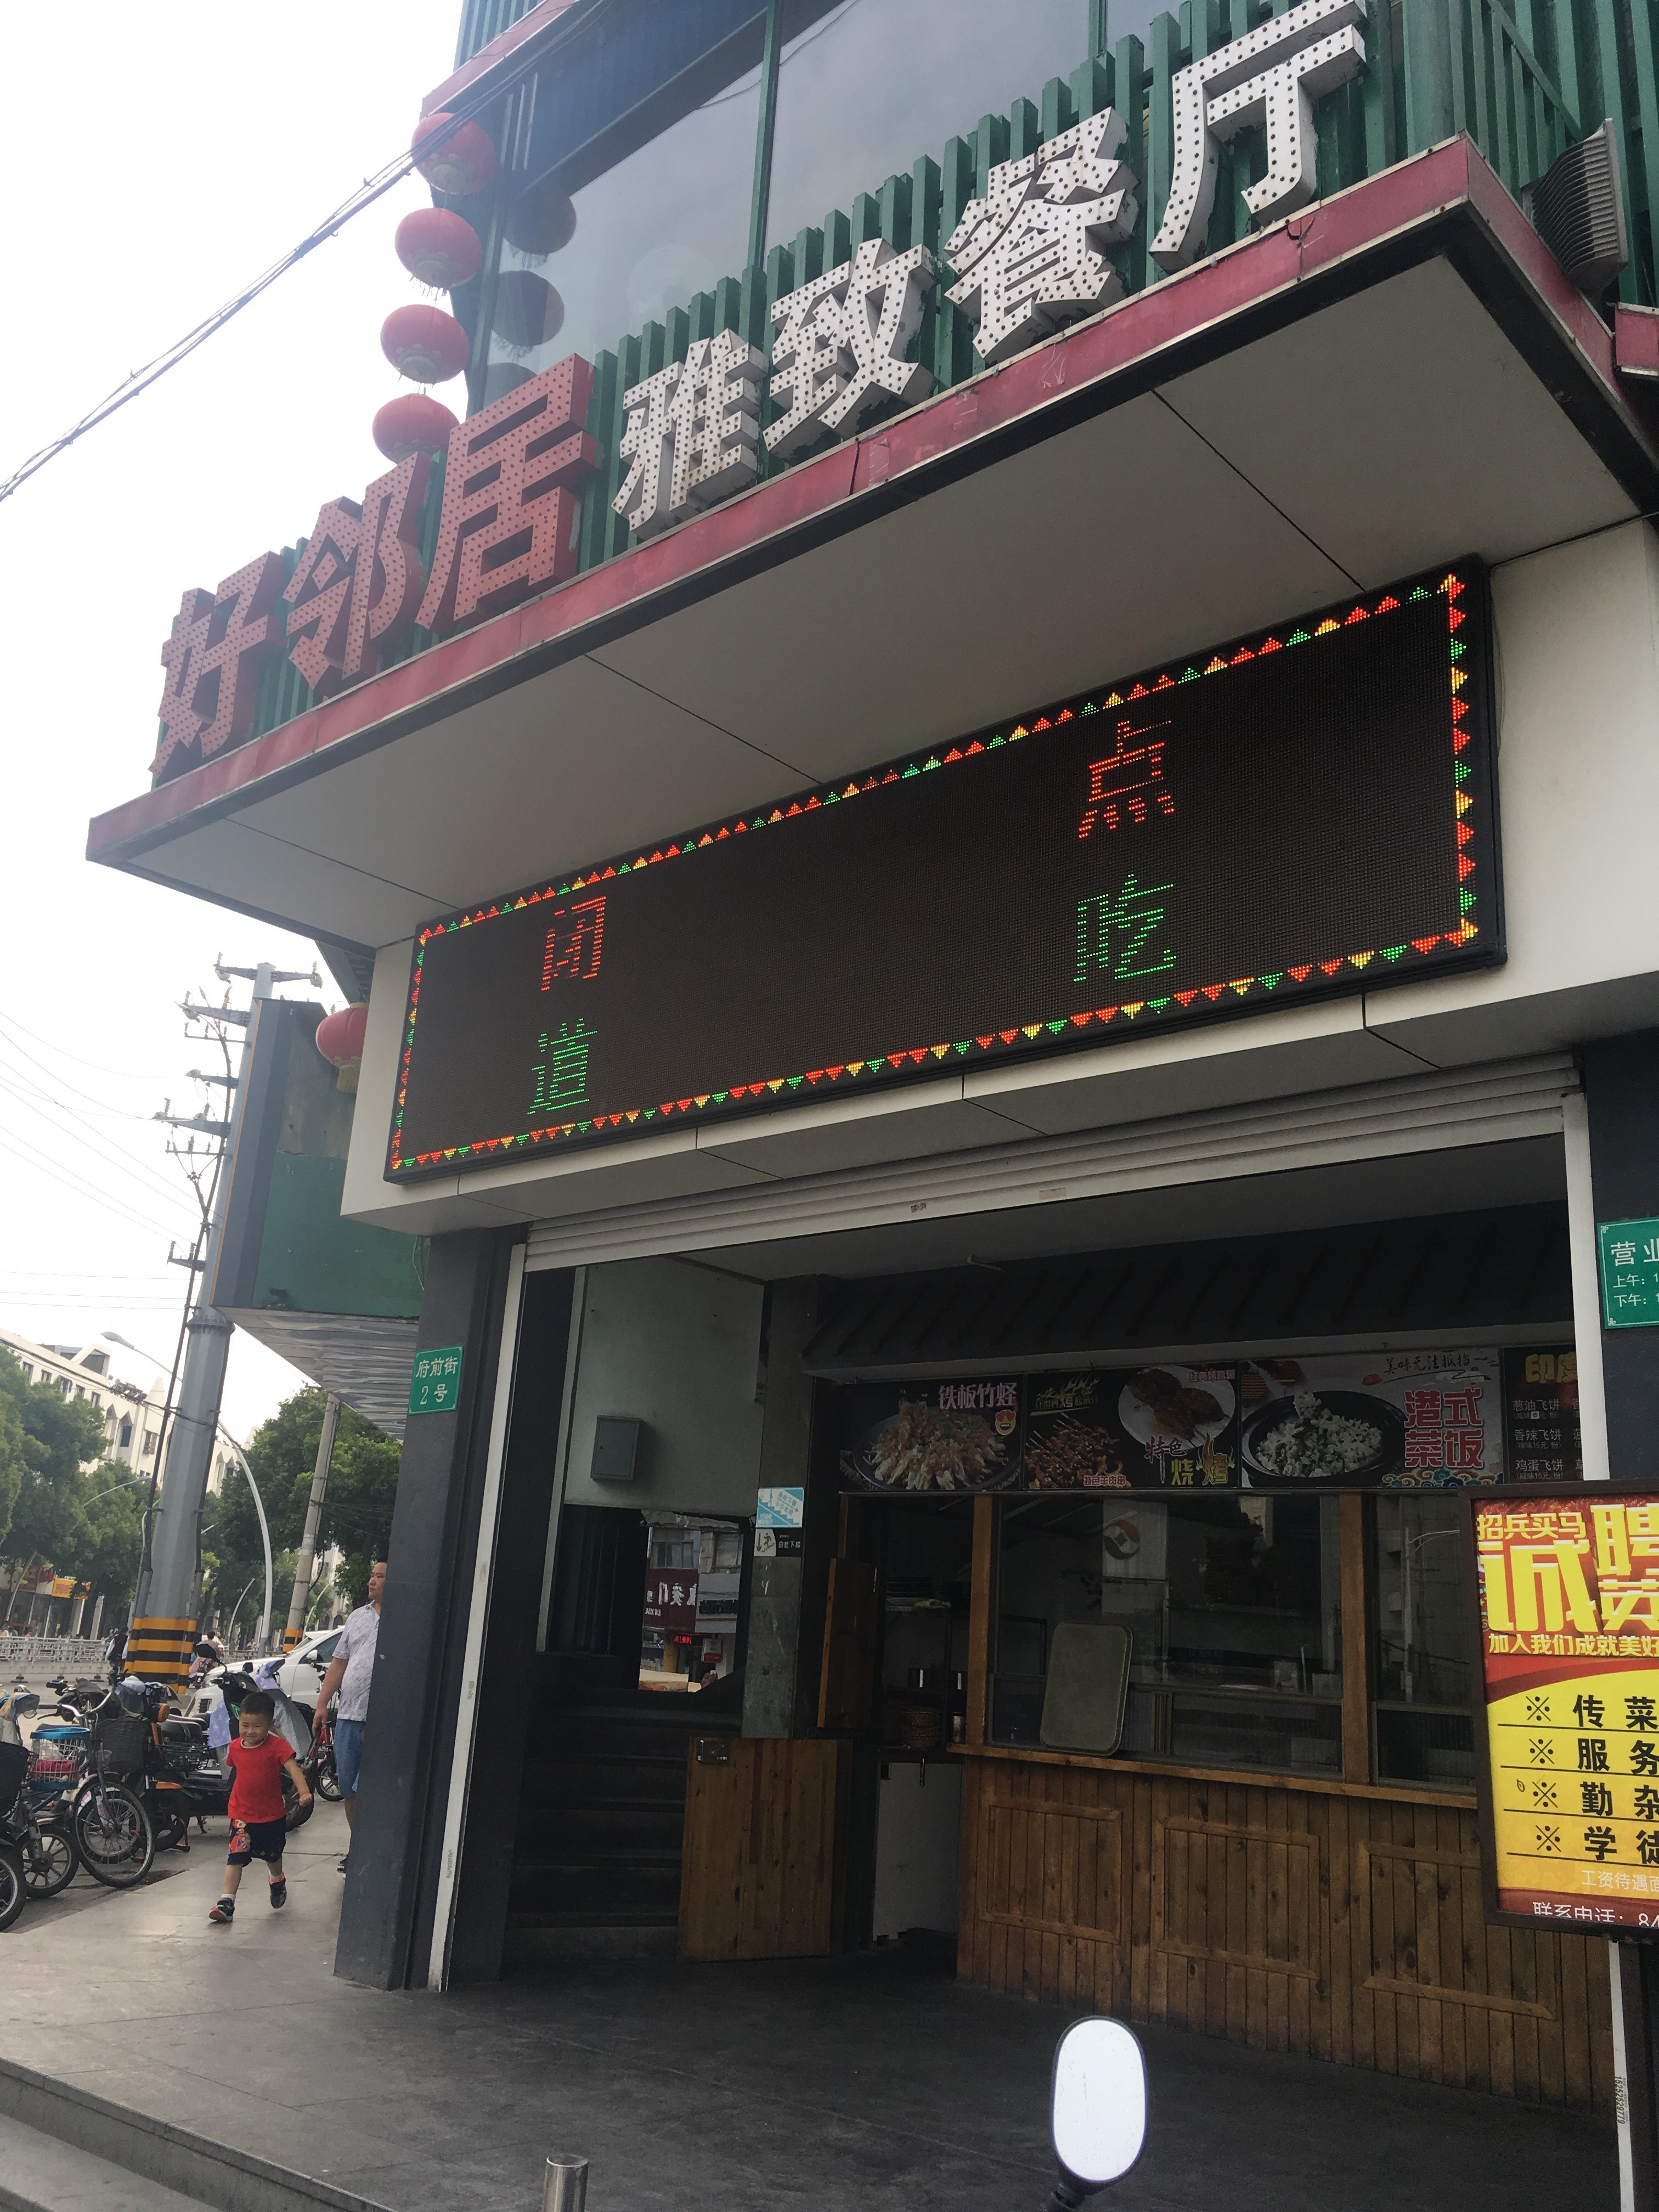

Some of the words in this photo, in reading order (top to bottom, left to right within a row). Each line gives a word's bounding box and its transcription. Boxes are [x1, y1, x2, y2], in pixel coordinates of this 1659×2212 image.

[148, 351, 597, 778] 好邻居
[610, 0, 1368, 539] 雅致餐厅
[1078, 720, 1175, 839] 点
[527, 1018, 598, 1115] 道
[1610, 1238, 1659, 1266] 营业
[415, 1356, 459, 1378] 府前街
[420, 1383, 448, 1405] 2号
[1404, 1387, 1483, 1428] 港式
[1513, 1398, 1560, 1412] 葱油飞饼
[1404, 1429, 1485, 1469] 菜饭
[1514, 1429, 1562, 1441] 香辣飞饼
[1170, 1435, 1231, 1486] 烧烤
[1516, 1459, 1564, 1471] 鸡蛋飞饼
[1477, 1512, 1587, 1540] 招兵买马
[1477, 1539, 1599, 1633] 诚
[1488, 1633, 1659, 1657] 加入我们成就美好
